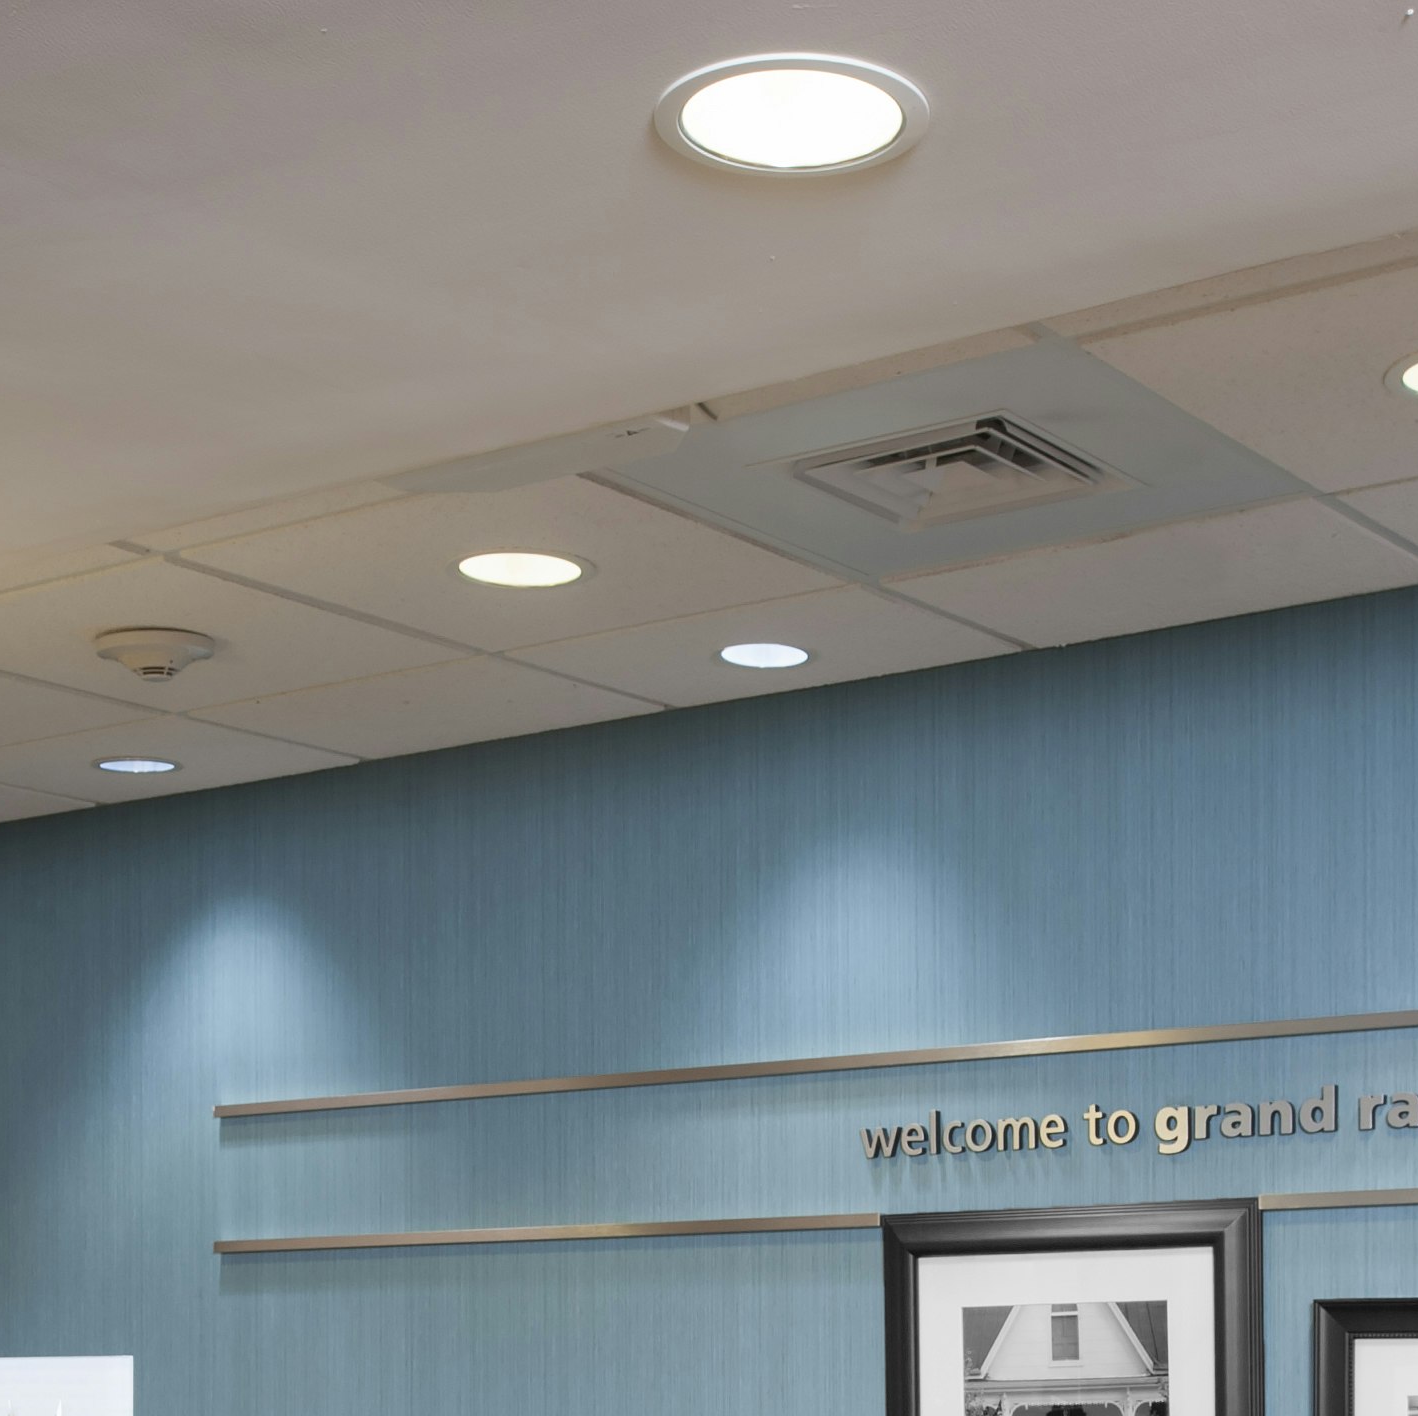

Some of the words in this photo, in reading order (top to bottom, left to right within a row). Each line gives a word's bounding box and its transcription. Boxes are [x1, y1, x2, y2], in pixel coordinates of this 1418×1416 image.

[861, 1109, 1069, 1160] welcome
[1083, 1103, 1139, 1148] to
[1155, 1084, 1338, 1155] grand
